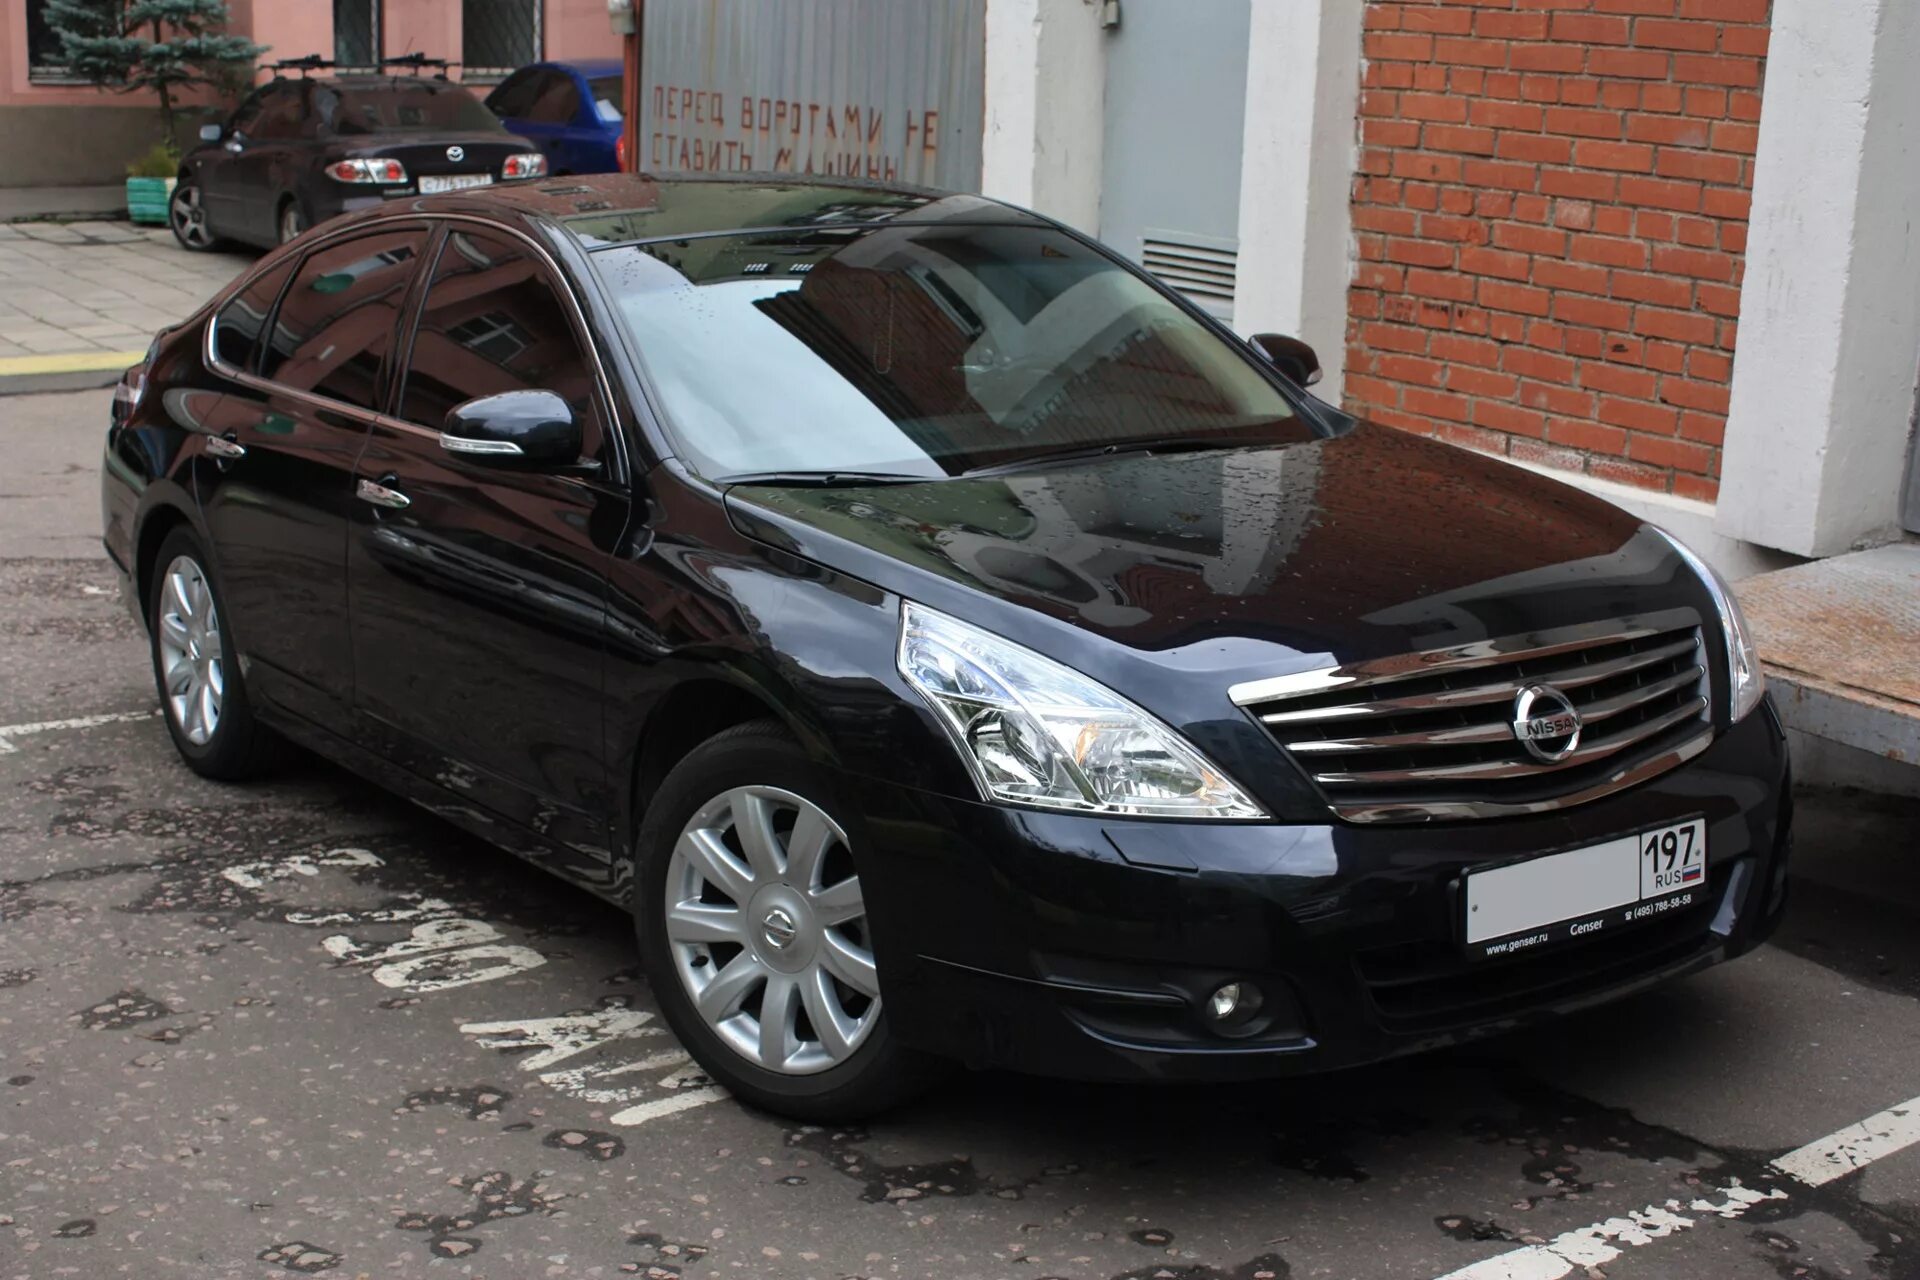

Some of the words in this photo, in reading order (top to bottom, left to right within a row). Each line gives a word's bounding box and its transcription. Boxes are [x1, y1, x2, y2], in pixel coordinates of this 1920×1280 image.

[654, 86, 724, 127] ПЕРЕД
[741, 96, 882, 143] ВОРОТАМИ
[906, 109, 938, 150] НЕ
[652, 133, 752, 172] СТАВИТЬ
[1527, 715, 1582, 735] NISSAN
[1644, 825, 1696, 873] 197
[1655, 870, 1682, 889] RUS
[1486, 932, 1549, 956] www.genser.ru
[1633, 903, 1654, 920] (495)
[1655, 894, 1691, 912] 788-58-58
